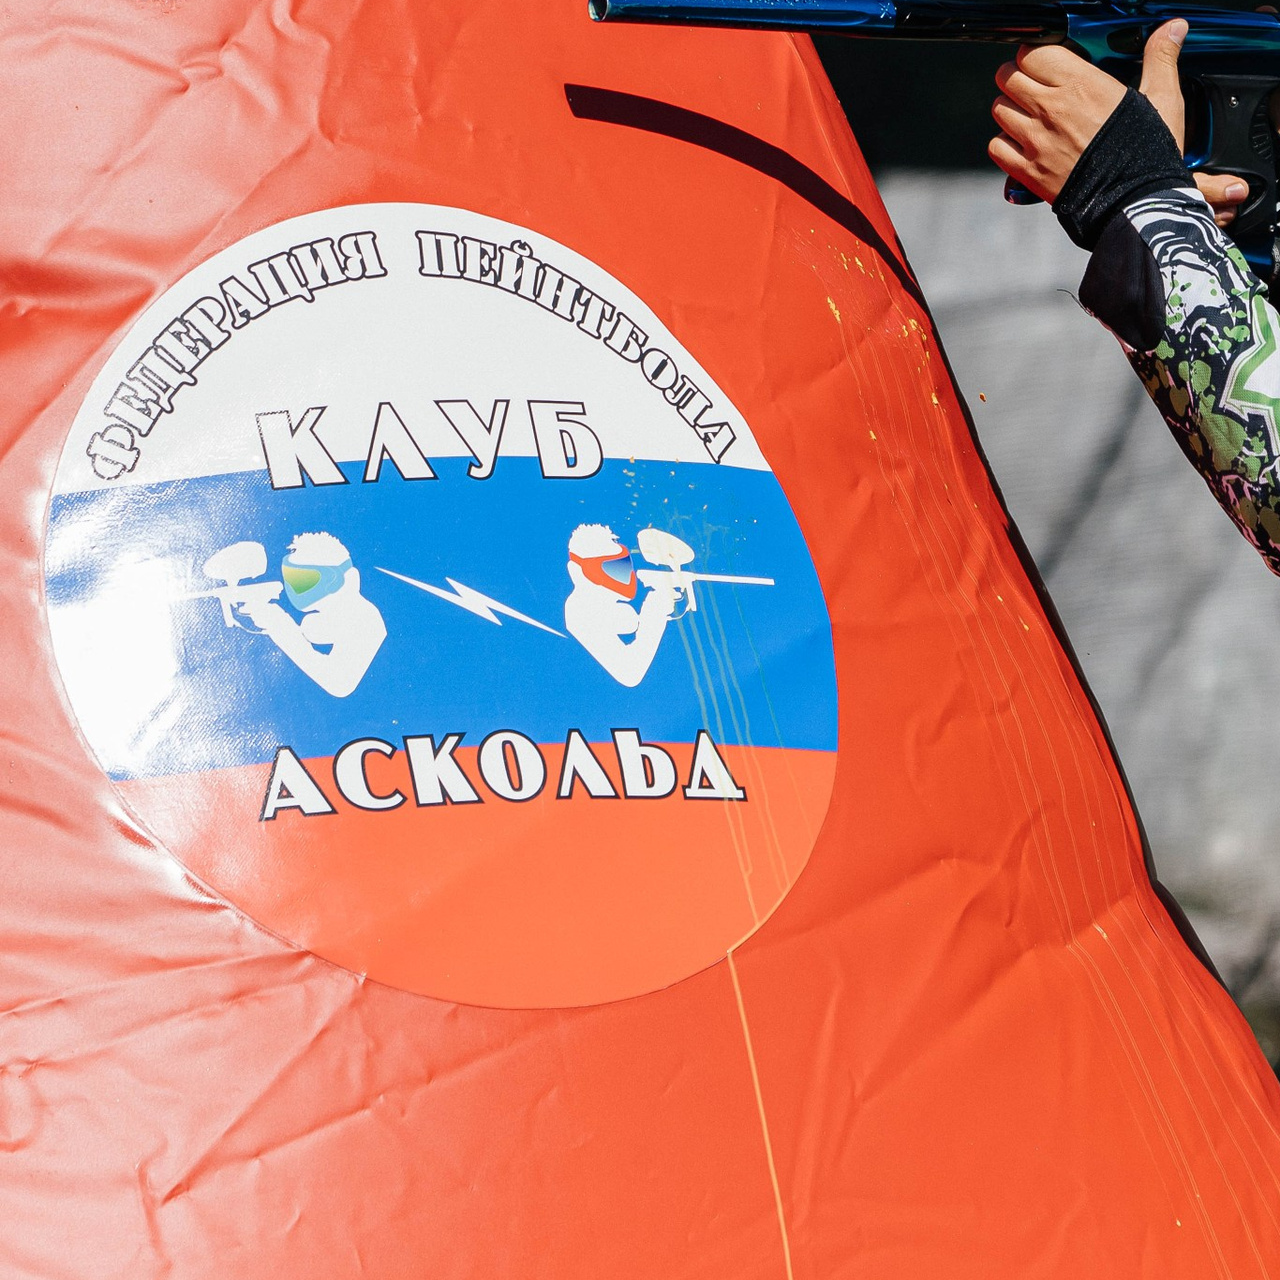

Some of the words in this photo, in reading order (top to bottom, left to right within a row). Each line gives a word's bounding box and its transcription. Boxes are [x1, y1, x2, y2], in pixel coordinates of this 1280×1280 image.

[86, 231, 388, 480] ФЕДЕРАЦИЯ
[415, 230, 737, 463] ПЕЙНТБОЛА
[254, 399, 605, 490] КЛУБ
[258, 728, 748, 821] АСКОЛЬД
